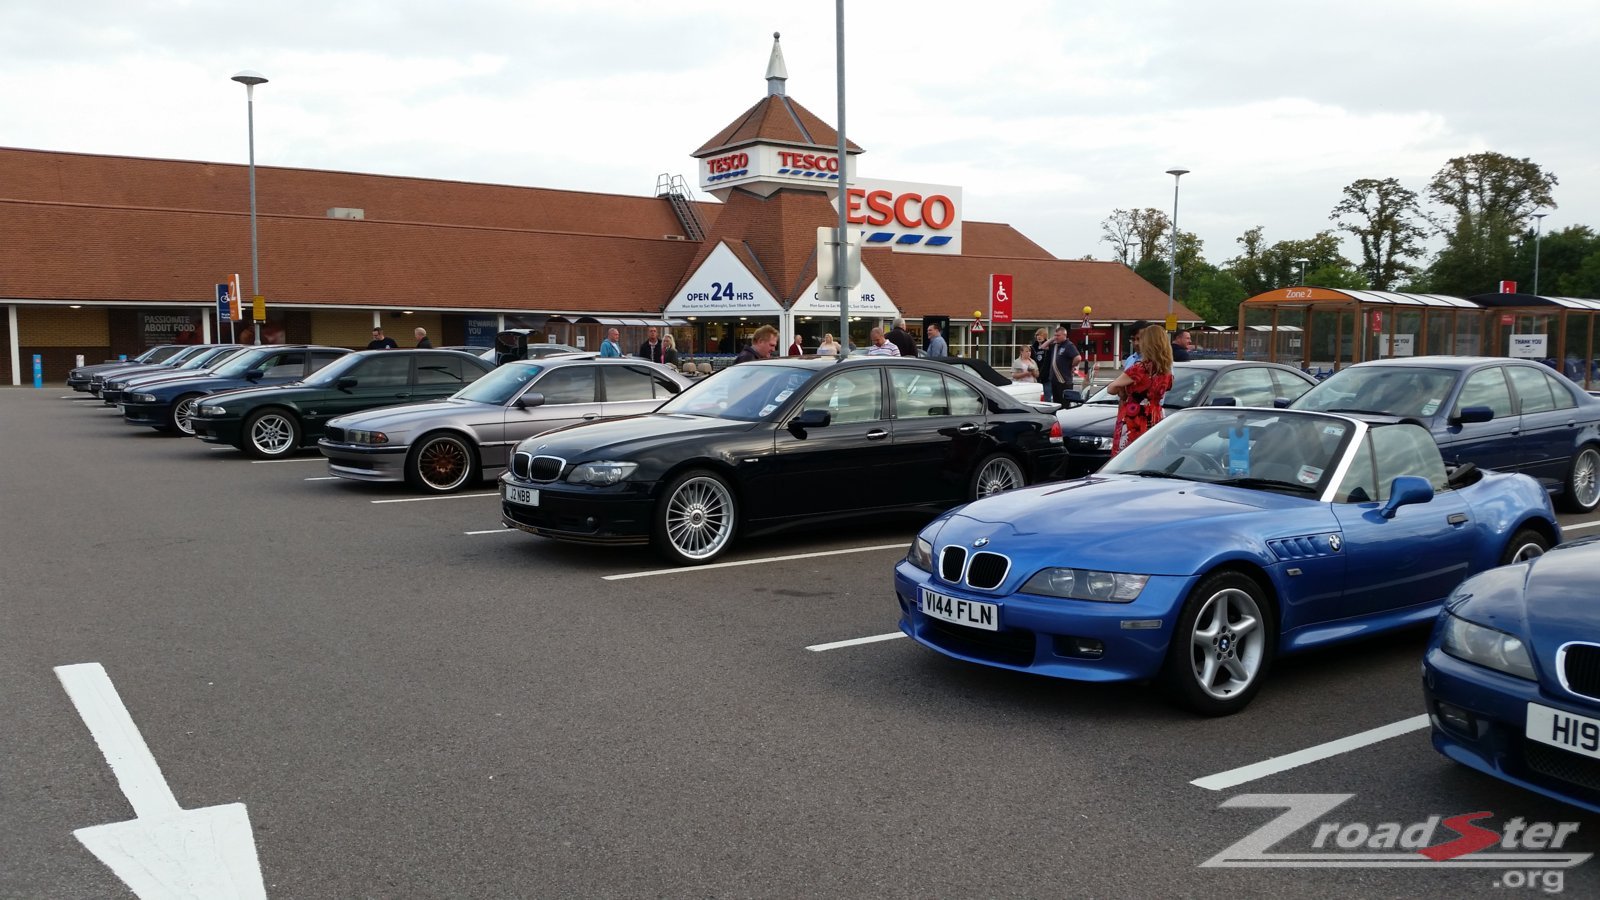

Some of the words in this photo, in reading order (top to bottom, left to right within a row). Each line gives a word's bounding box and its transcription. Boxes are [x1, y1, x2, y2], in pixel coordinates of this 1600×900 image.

[707, 152, 749, 175] TESCO
[778, 151, 839, 172] TESCO
[846, 188, 955, 230] ESCO
[230, 281, 236, 301] 2
[686, 293, 709, 301] OPEN
[711, 282, 734, 301] 24
[736, 292, 754, 301] HRS
[1286, 290, 1306, 298] Zone
[1307, 289, 1312, 297] 2
[144, 315, 191, 323] PASSIONATE
[145, 324, 171, 332] ABOUT
[174, 324, 195, 332] FOOD
[510, 490, 517, 500] J2
[518, 490, 531, 503] NBB
[925, 591, 953, 617] V144
[957, 600, 991, 625] FLN
[1552, 714, 1600, 752] H19
